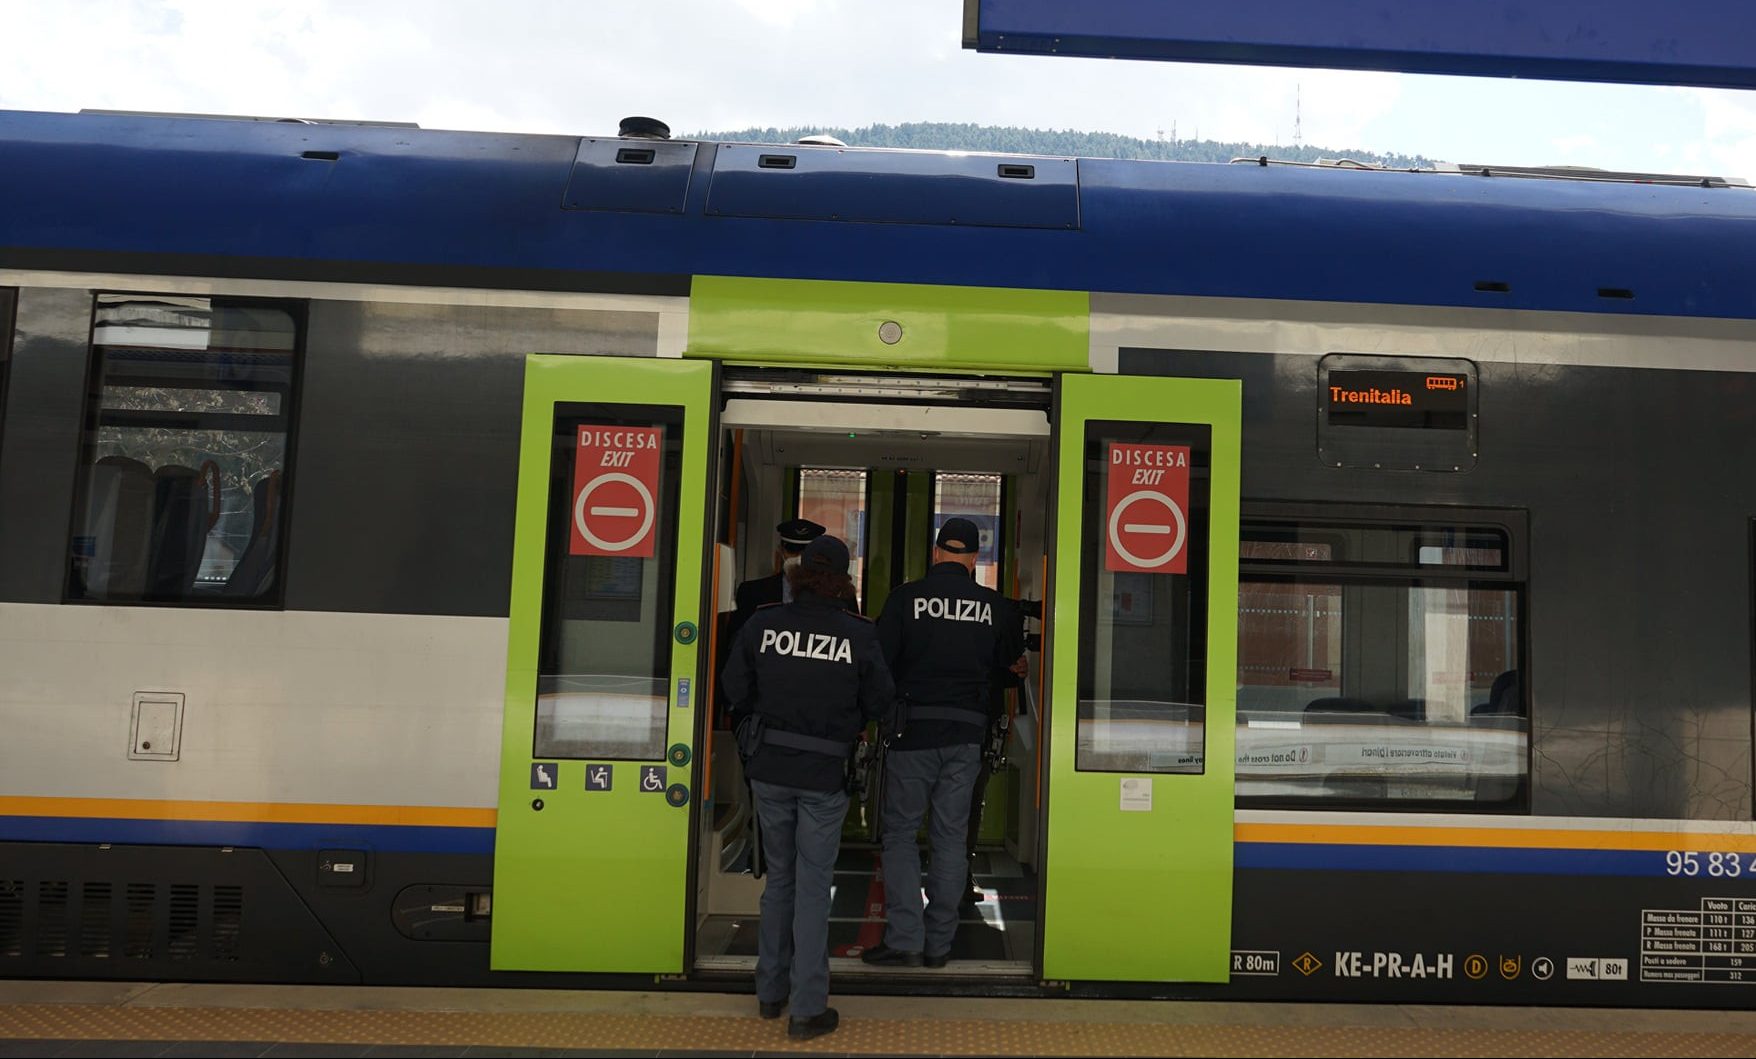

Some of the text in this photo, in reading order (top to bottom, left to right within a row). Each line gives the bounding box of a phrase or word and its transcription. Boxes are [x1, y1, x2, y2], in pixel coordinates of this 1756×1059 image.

[1458, 380, 1465, 389] 1
[1330, 386, 1412, 406] Trenitalia
[580, 430, 657, 449] DISCESA
[600, 450, 635, 467] EXIT
[1112, 449, 1186, 467] DISCESA
[1132, 468, 1165, 485] EXIT
[914, 597, 993, 626] POLIZIA
[759, 628, 852, 664] POLIZIA
[1666, 850, 1700, 876] 95
[1708, 852, 1741, 877] 83
[1707, 901, 1728, 910] Vuoto
[1647, 913, 1667, 923] Massa
[1667, 913, 1675, 923] da
[1676, 914, 1699, 924] frenare
[1710, 914, 1723, 924] 110
[1742, 915, 1755, 925] 136
[1646, 927, 1652, 936] P
[1654, 927, 1673, 936] Massa
[1709, 928, 1722, 938] 111
[1741, 929, 1755, 938] 127
[1646, 940, 1652, 950] R
[1654, 941, 1673, 950] Massa
[1709, 942, 1722, 951] 168
[1740, 943, 1754, 952] 205
[1233, 954, 1275, 971] R 80m
[1303, 956, 1311, 971] R
[1335, 951, 1454, 979] KE-PR-A-H
[1471, 959, 1481, 974] D
[1605, 962, 1622, 975] 80t
[1644, 956, 1659, 965] Posti
[1665, 956, 1687, 966] sedere
[1730, 958, 1743, 967] 159
[1729, 971, 1742, 980] 312
